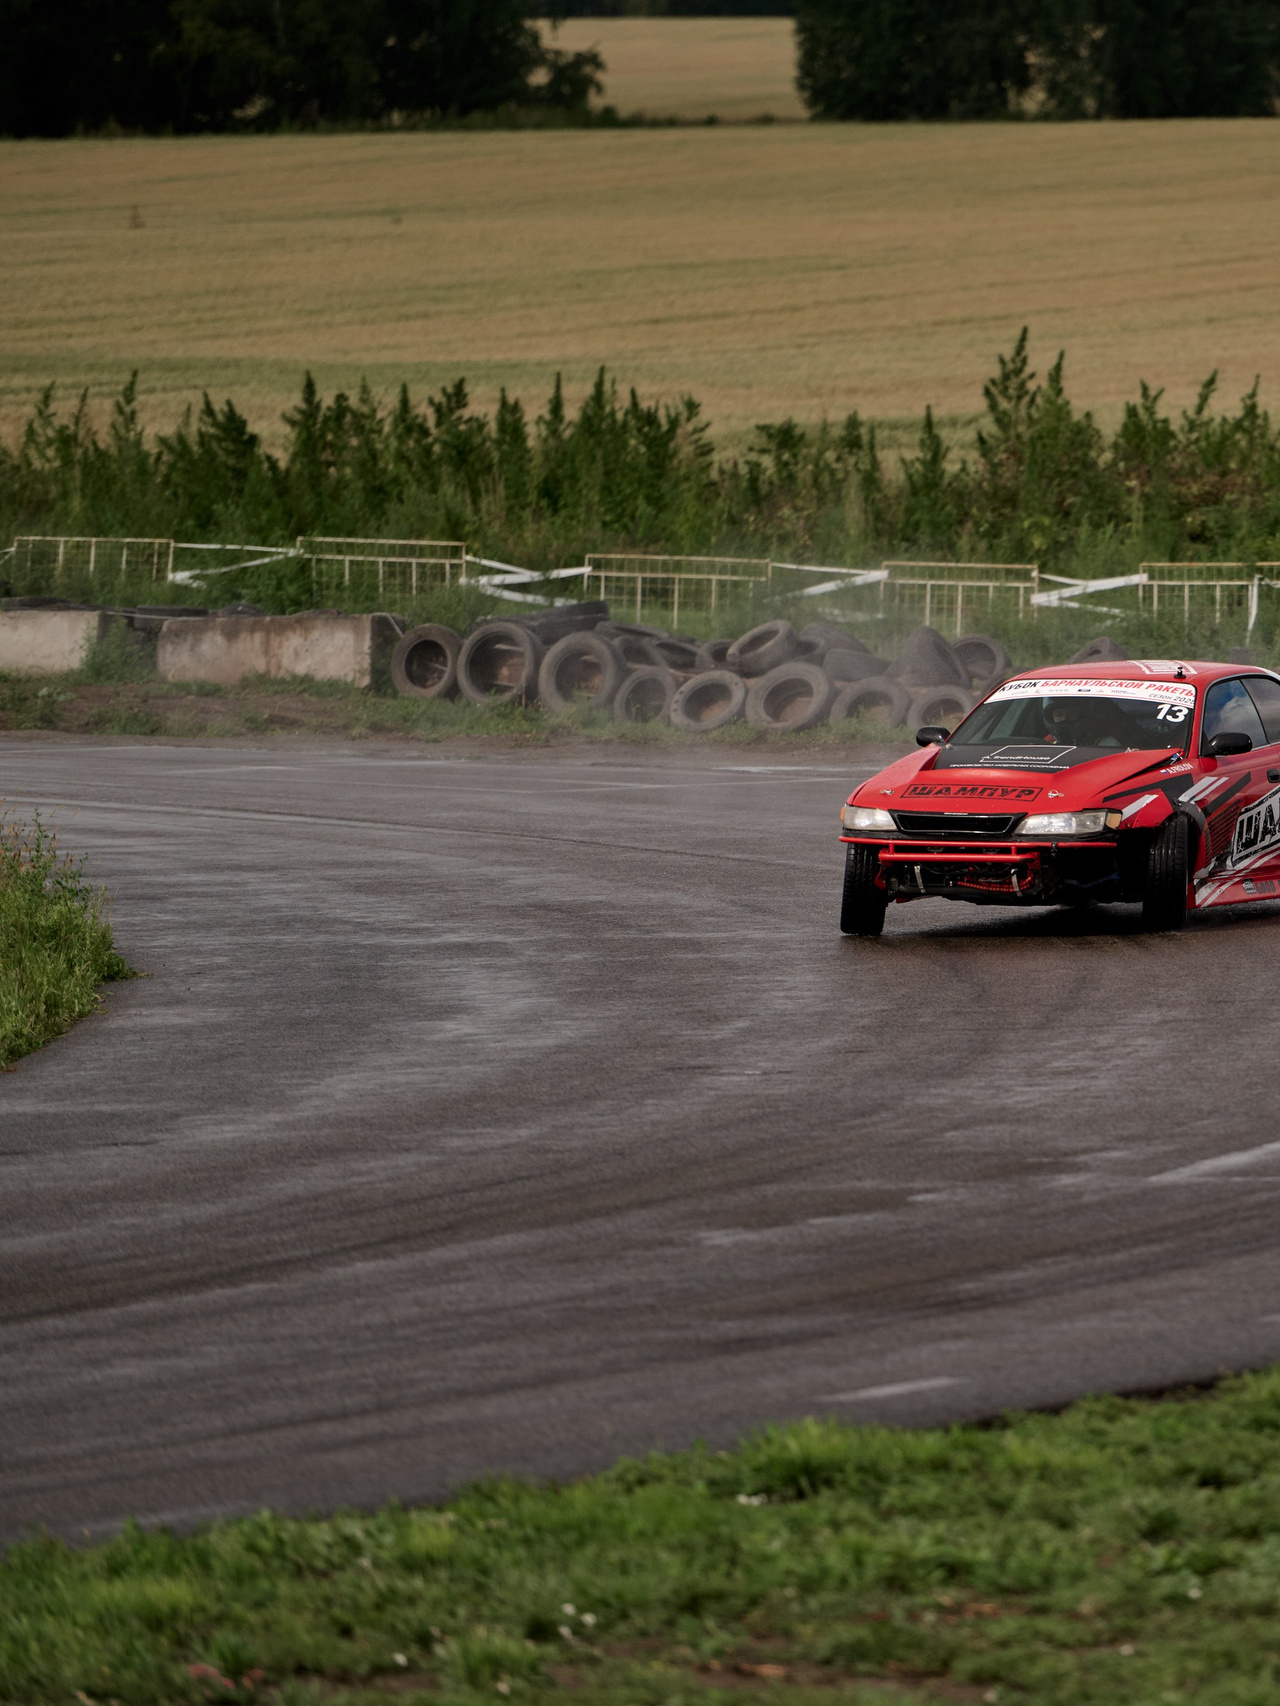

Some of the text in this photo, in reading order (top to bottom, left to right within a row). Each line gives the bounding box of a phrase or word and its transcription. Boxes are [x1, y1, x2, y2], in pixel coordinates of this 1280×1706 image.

[999, 681, 1040, 693] КУБОК
[1040, 680, 1144, 689] БАРНАУЛЬСКОЙ
[1156, 703, 1189, 723] 13
[907, 786, 1035, 799] ШАМПУР
[1255, 880, 1277, 895] GOOD
